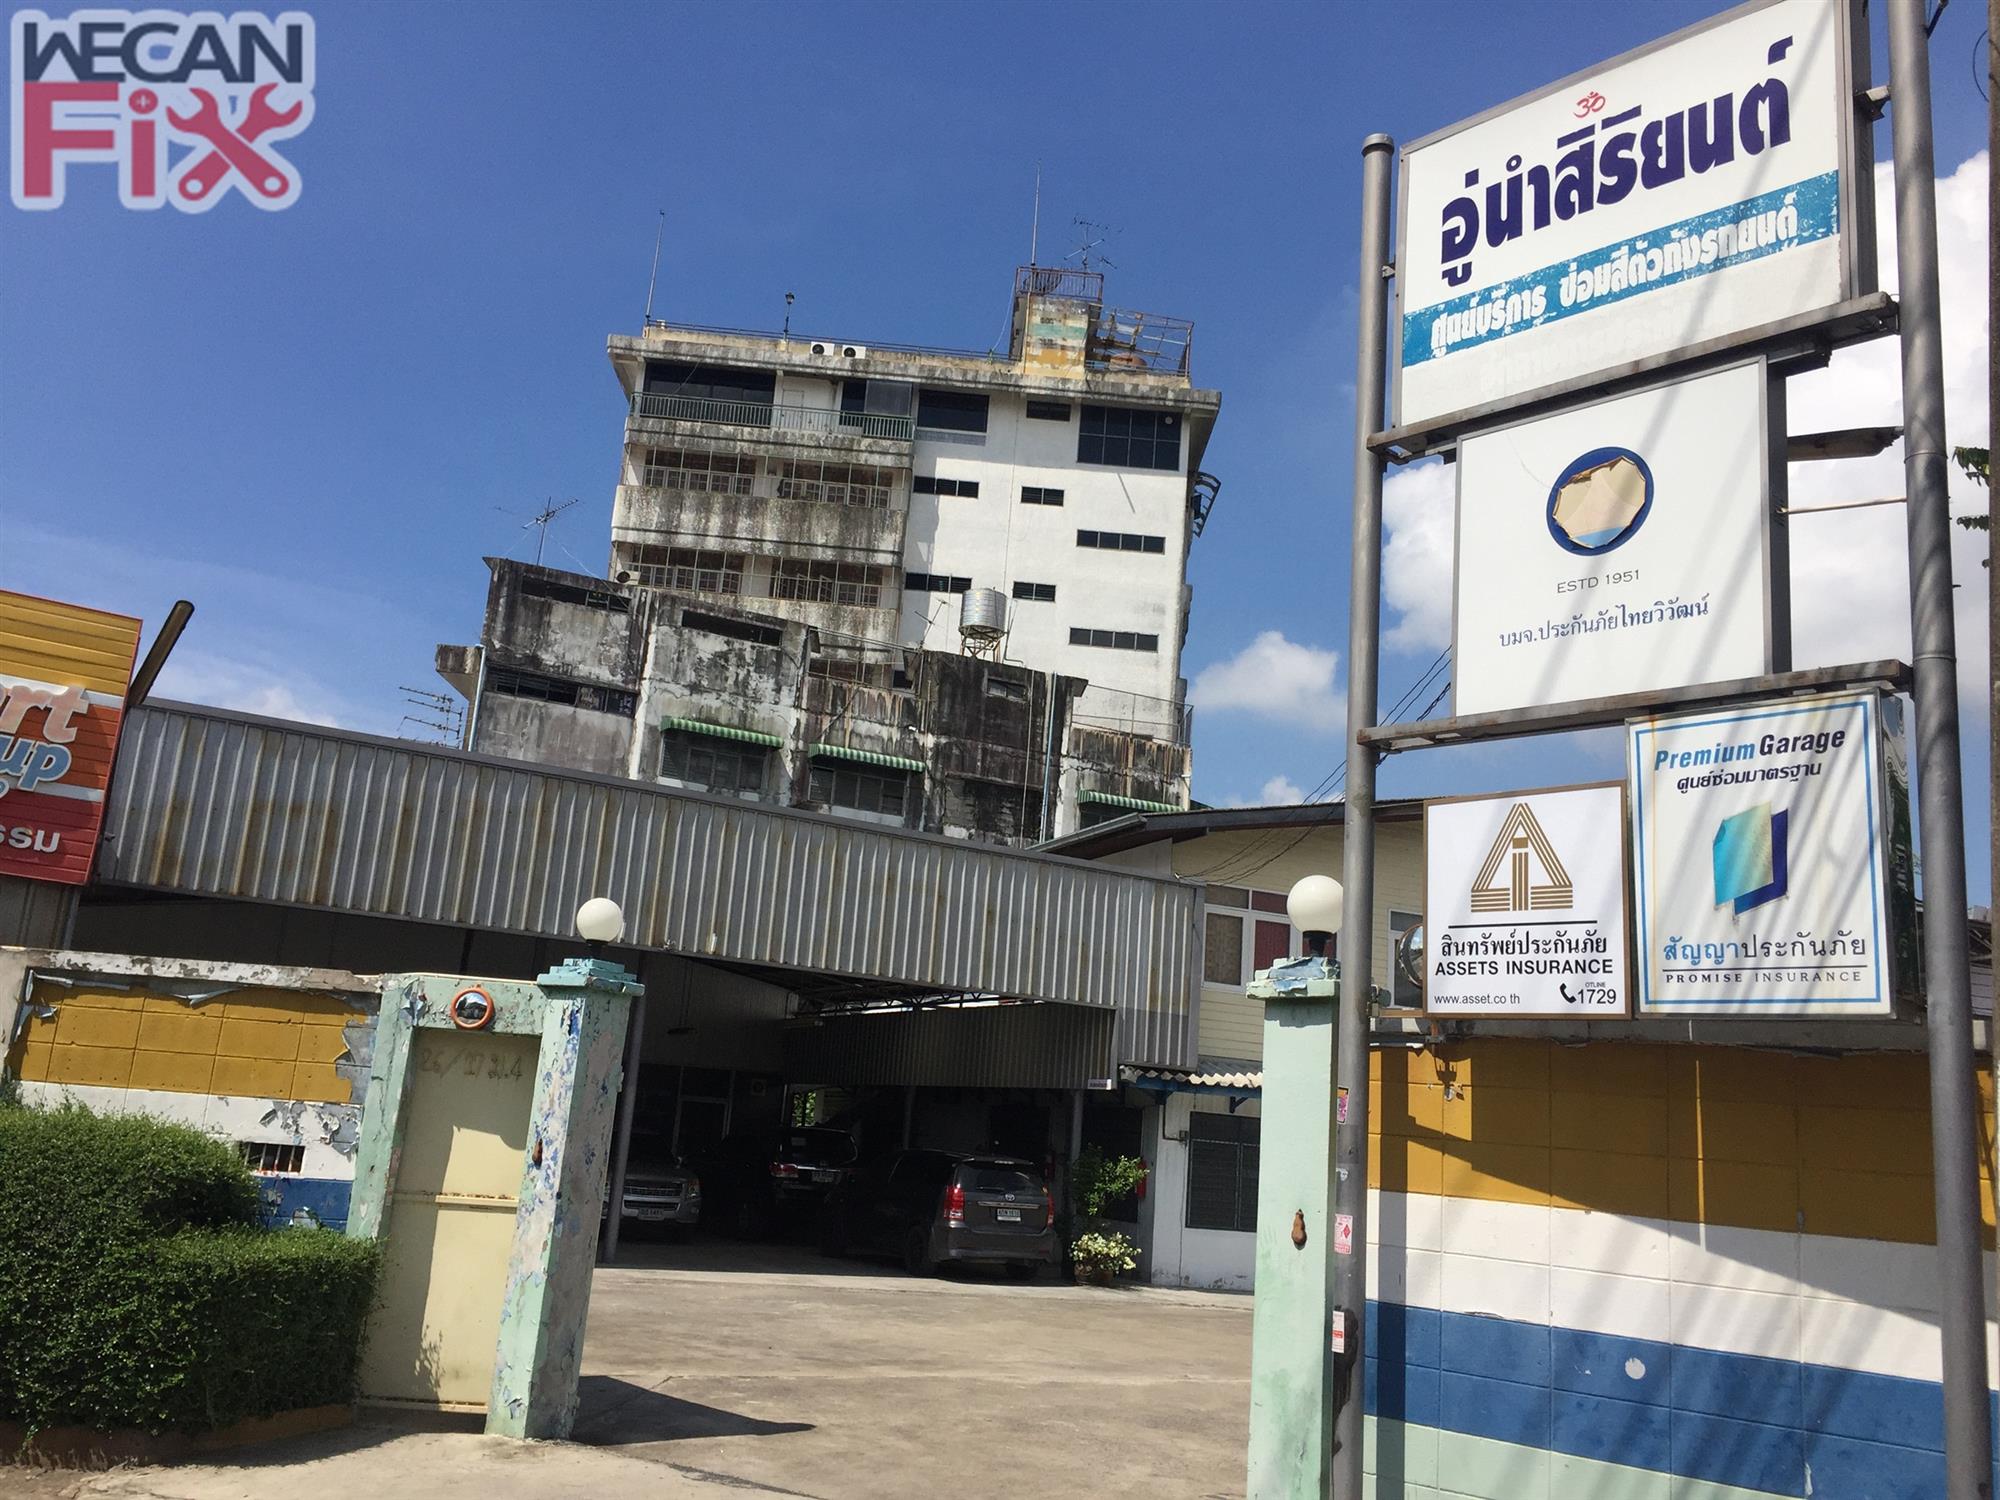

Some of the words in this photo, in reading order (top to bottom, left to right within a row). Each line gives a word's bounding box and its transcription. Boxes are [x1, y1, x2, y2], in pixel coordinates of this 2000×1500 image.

[1440, 35, 1793, 287] อู่นำสิริยนต์
[1431, 284, 1547, 358] ศูนย์บริการ
[1556, 576, 1600, 594] ESTD
[1605, 569, 1640, 586] 1951
[1499, 592, 1710, 648] บมจ.ประกันภัยไทยวิวัฒน์
[0, 684, 89, 743] rt
[1653, 741, 1756, 771] Premium
[1758, 729, 1847, 757] Garage
[1677, 762, 1822, 794] ศูนย์ซ่อมมาตรฐาน
[1441, 928, 1608, 957] สินทรัพย์ประกันภัย
[1663, 930, 1866, 966] สัญญาประกันภัย
[1435, 961, 1499, 976] ASSETS
[1506, 959, 1614, 975] INSURANCE
[1666, 973, 1743, 984] PROMISE
[1755, 971, 1862, 984] INSURANCE
[1577, 989, 1617, 1004] 1729
